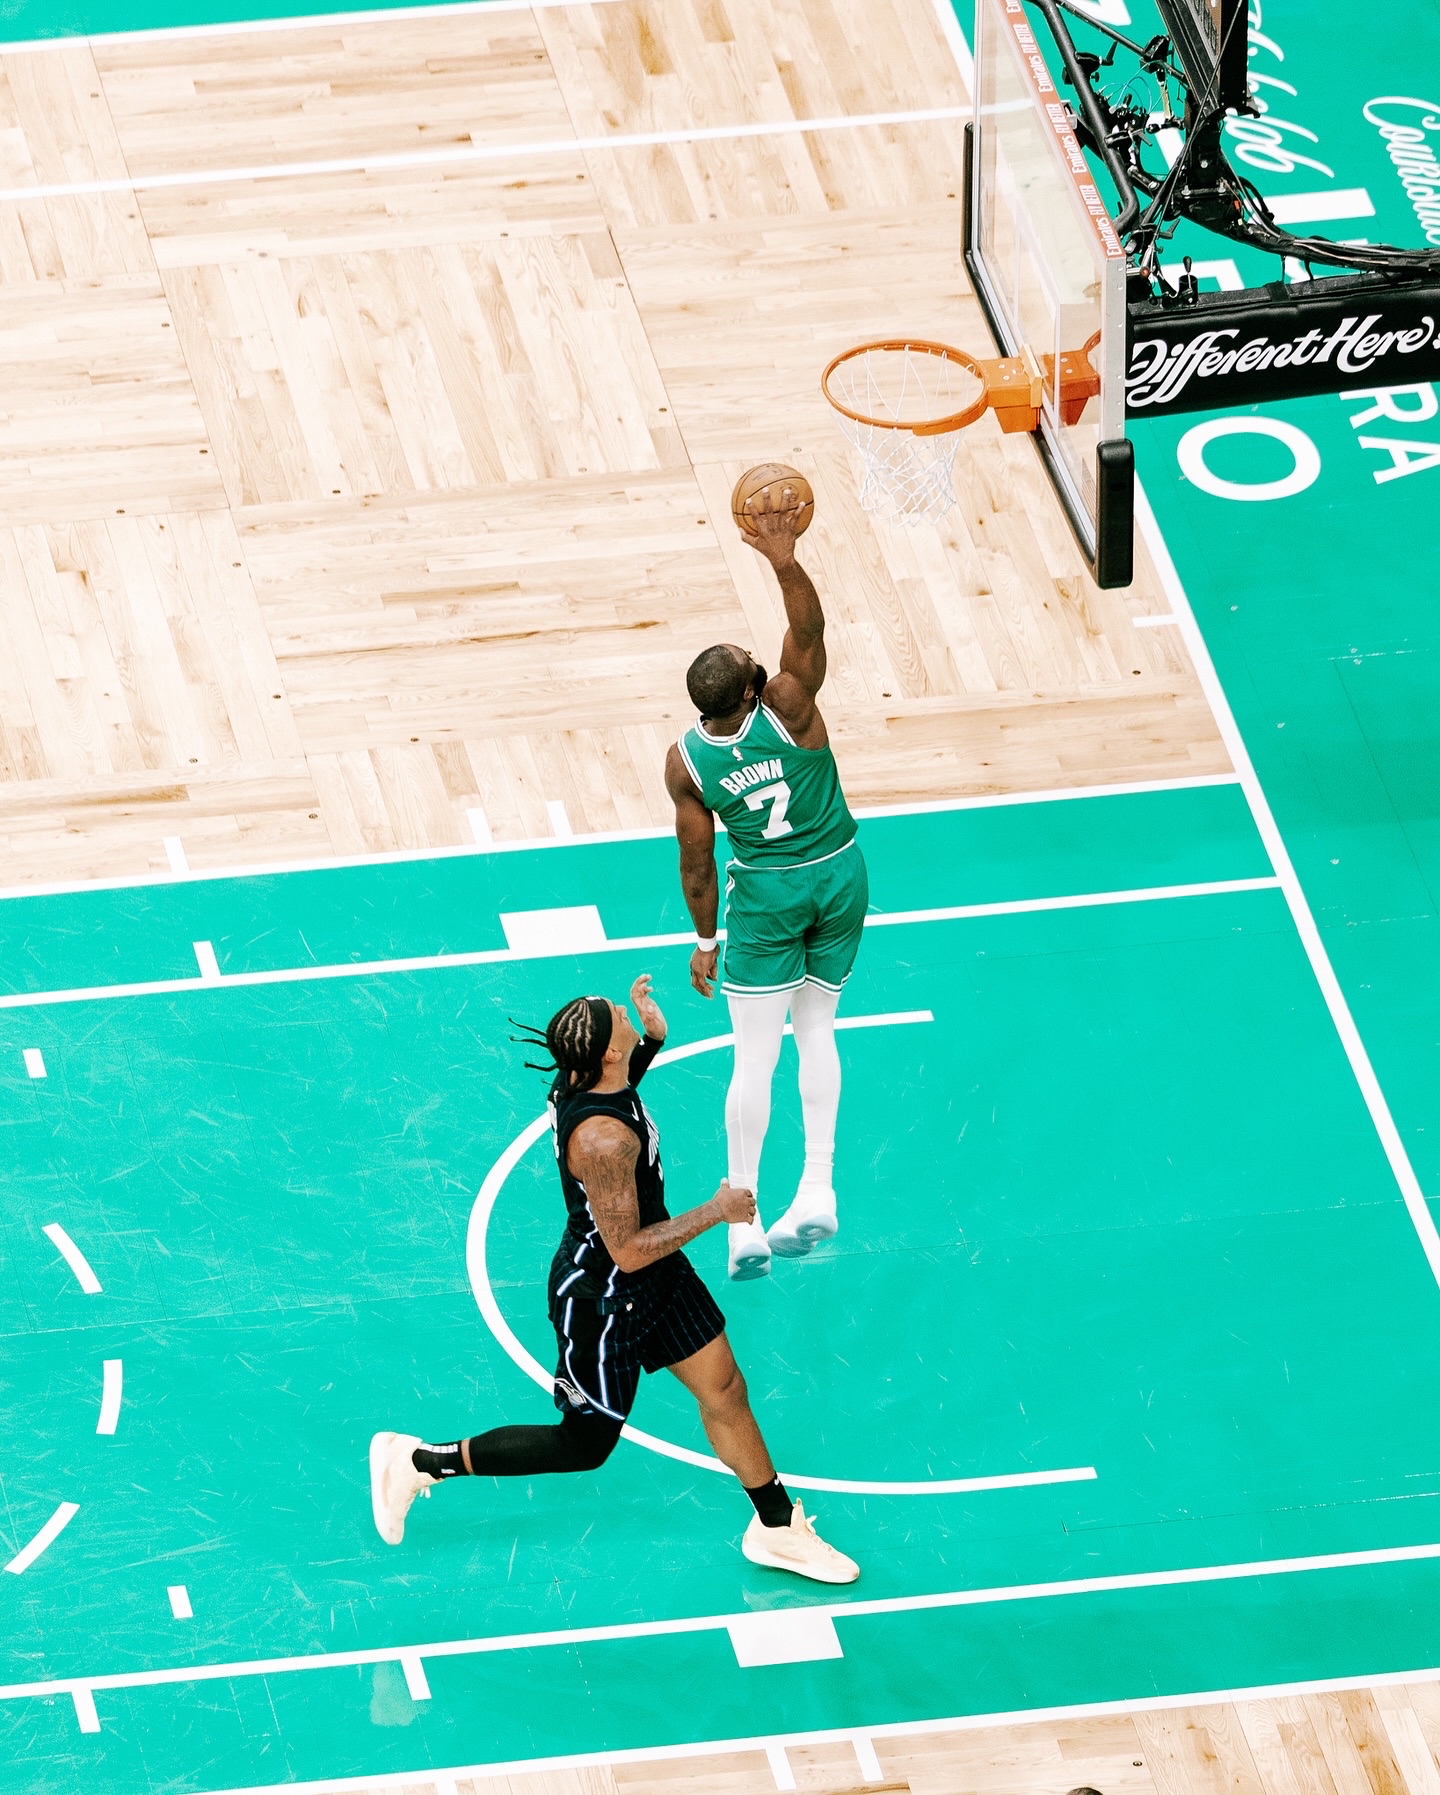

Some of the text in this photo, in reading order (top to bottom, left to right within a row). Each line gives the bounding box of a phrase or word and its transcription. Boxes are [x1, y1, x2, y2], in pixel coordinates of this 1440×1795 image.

[1029, 55, 1053, 92] Emirates
[1062, 135, 1087, 174] Emirates
[1096, 217, 1121, 257] Emirates
[718, 758, 784, 796] BROWN
[743, 780, 793, 840] 7
